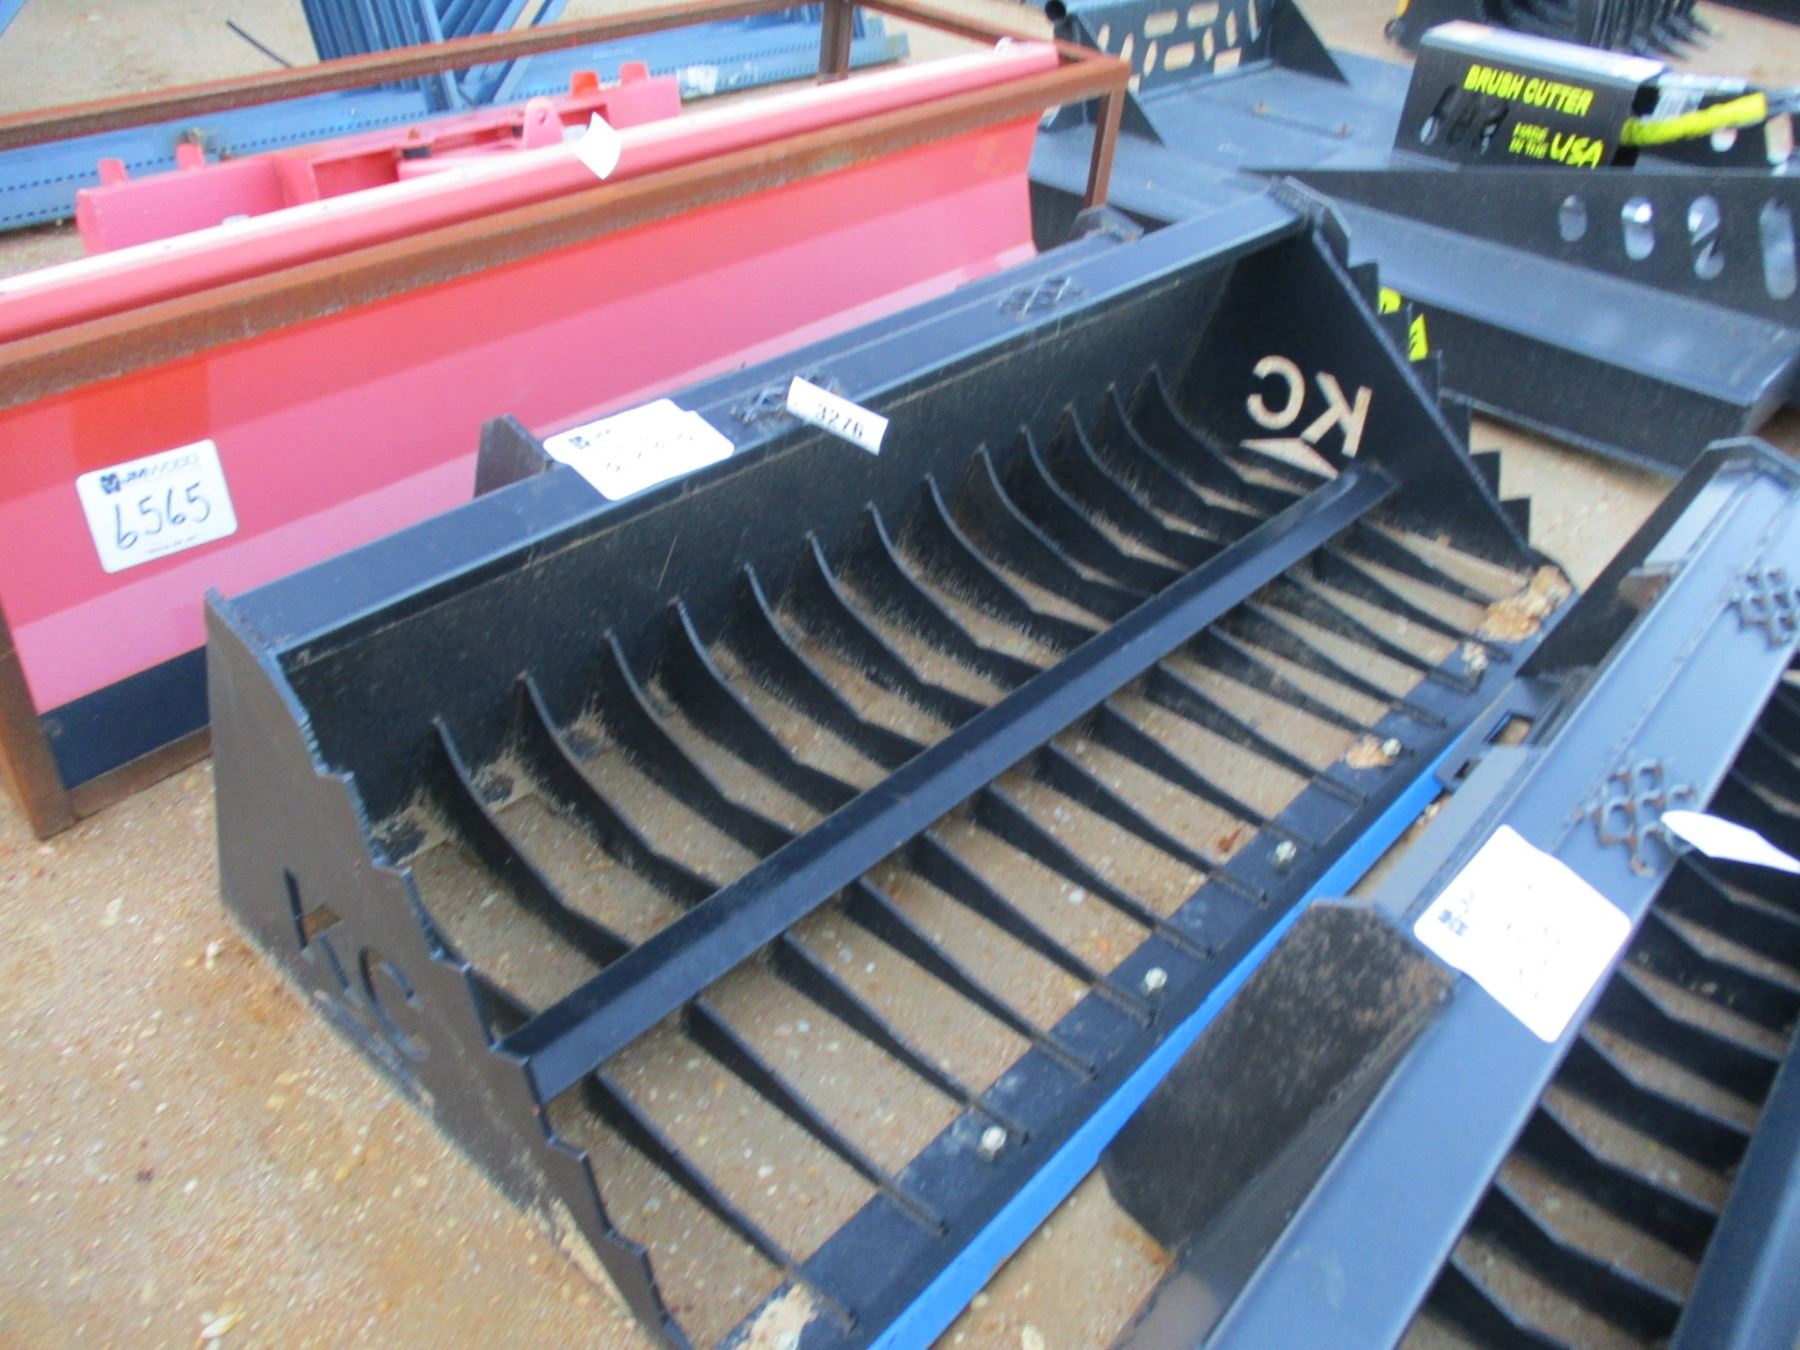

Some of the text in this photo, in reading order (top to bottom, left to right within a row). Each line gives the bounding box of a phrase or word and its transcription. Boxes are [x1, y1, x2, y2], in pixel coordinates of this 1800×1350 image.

[1463, 64, 1594, 117] BRUSH CUTTER
[1550, 131, 1604, 170] USA
[115, 482, 211, 550] 6565
